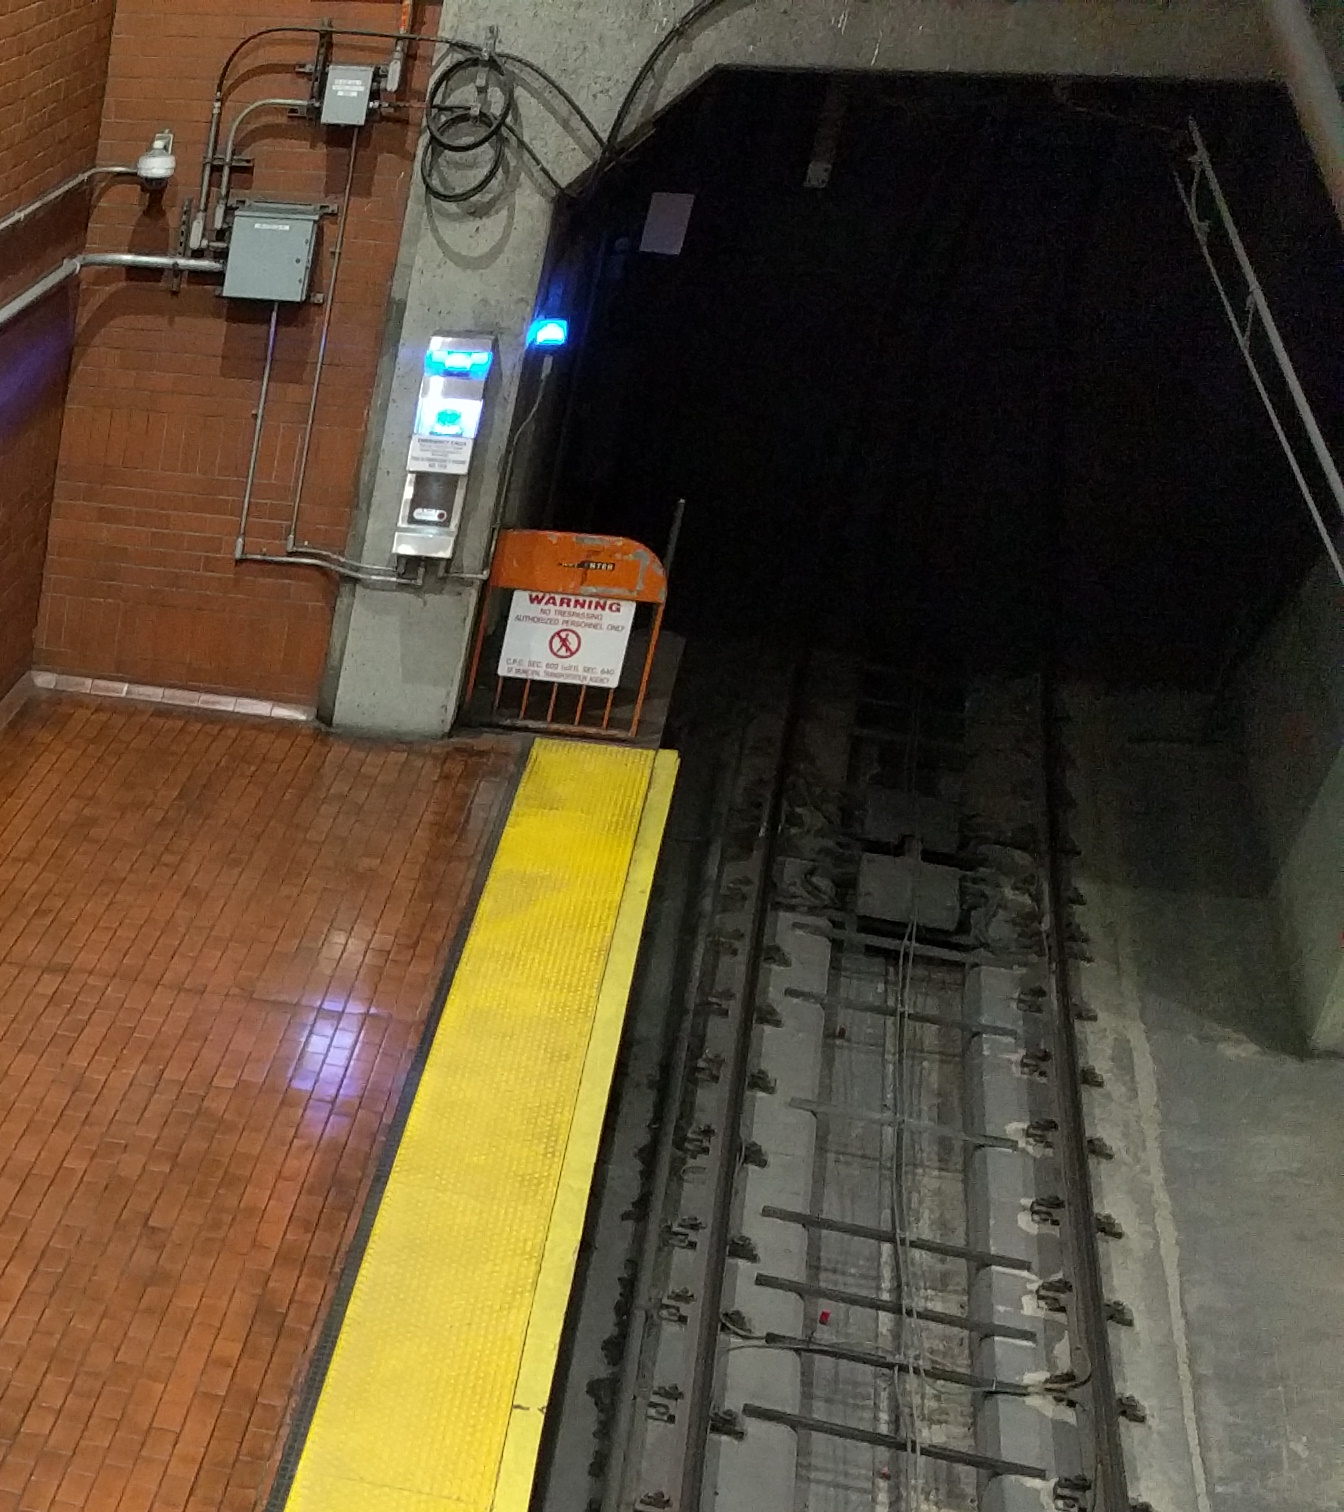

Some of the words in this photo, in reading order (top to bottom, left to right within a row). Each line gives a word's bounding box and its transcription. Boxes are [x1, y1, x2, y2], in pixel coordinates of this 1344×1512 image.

[528, 593, 622, 613] WARNING
[540, 608, 552, 617] NO
[514, 614, 559, 626] AUTHORIZED
[561, 619, 604, 631] PERSONNEL
